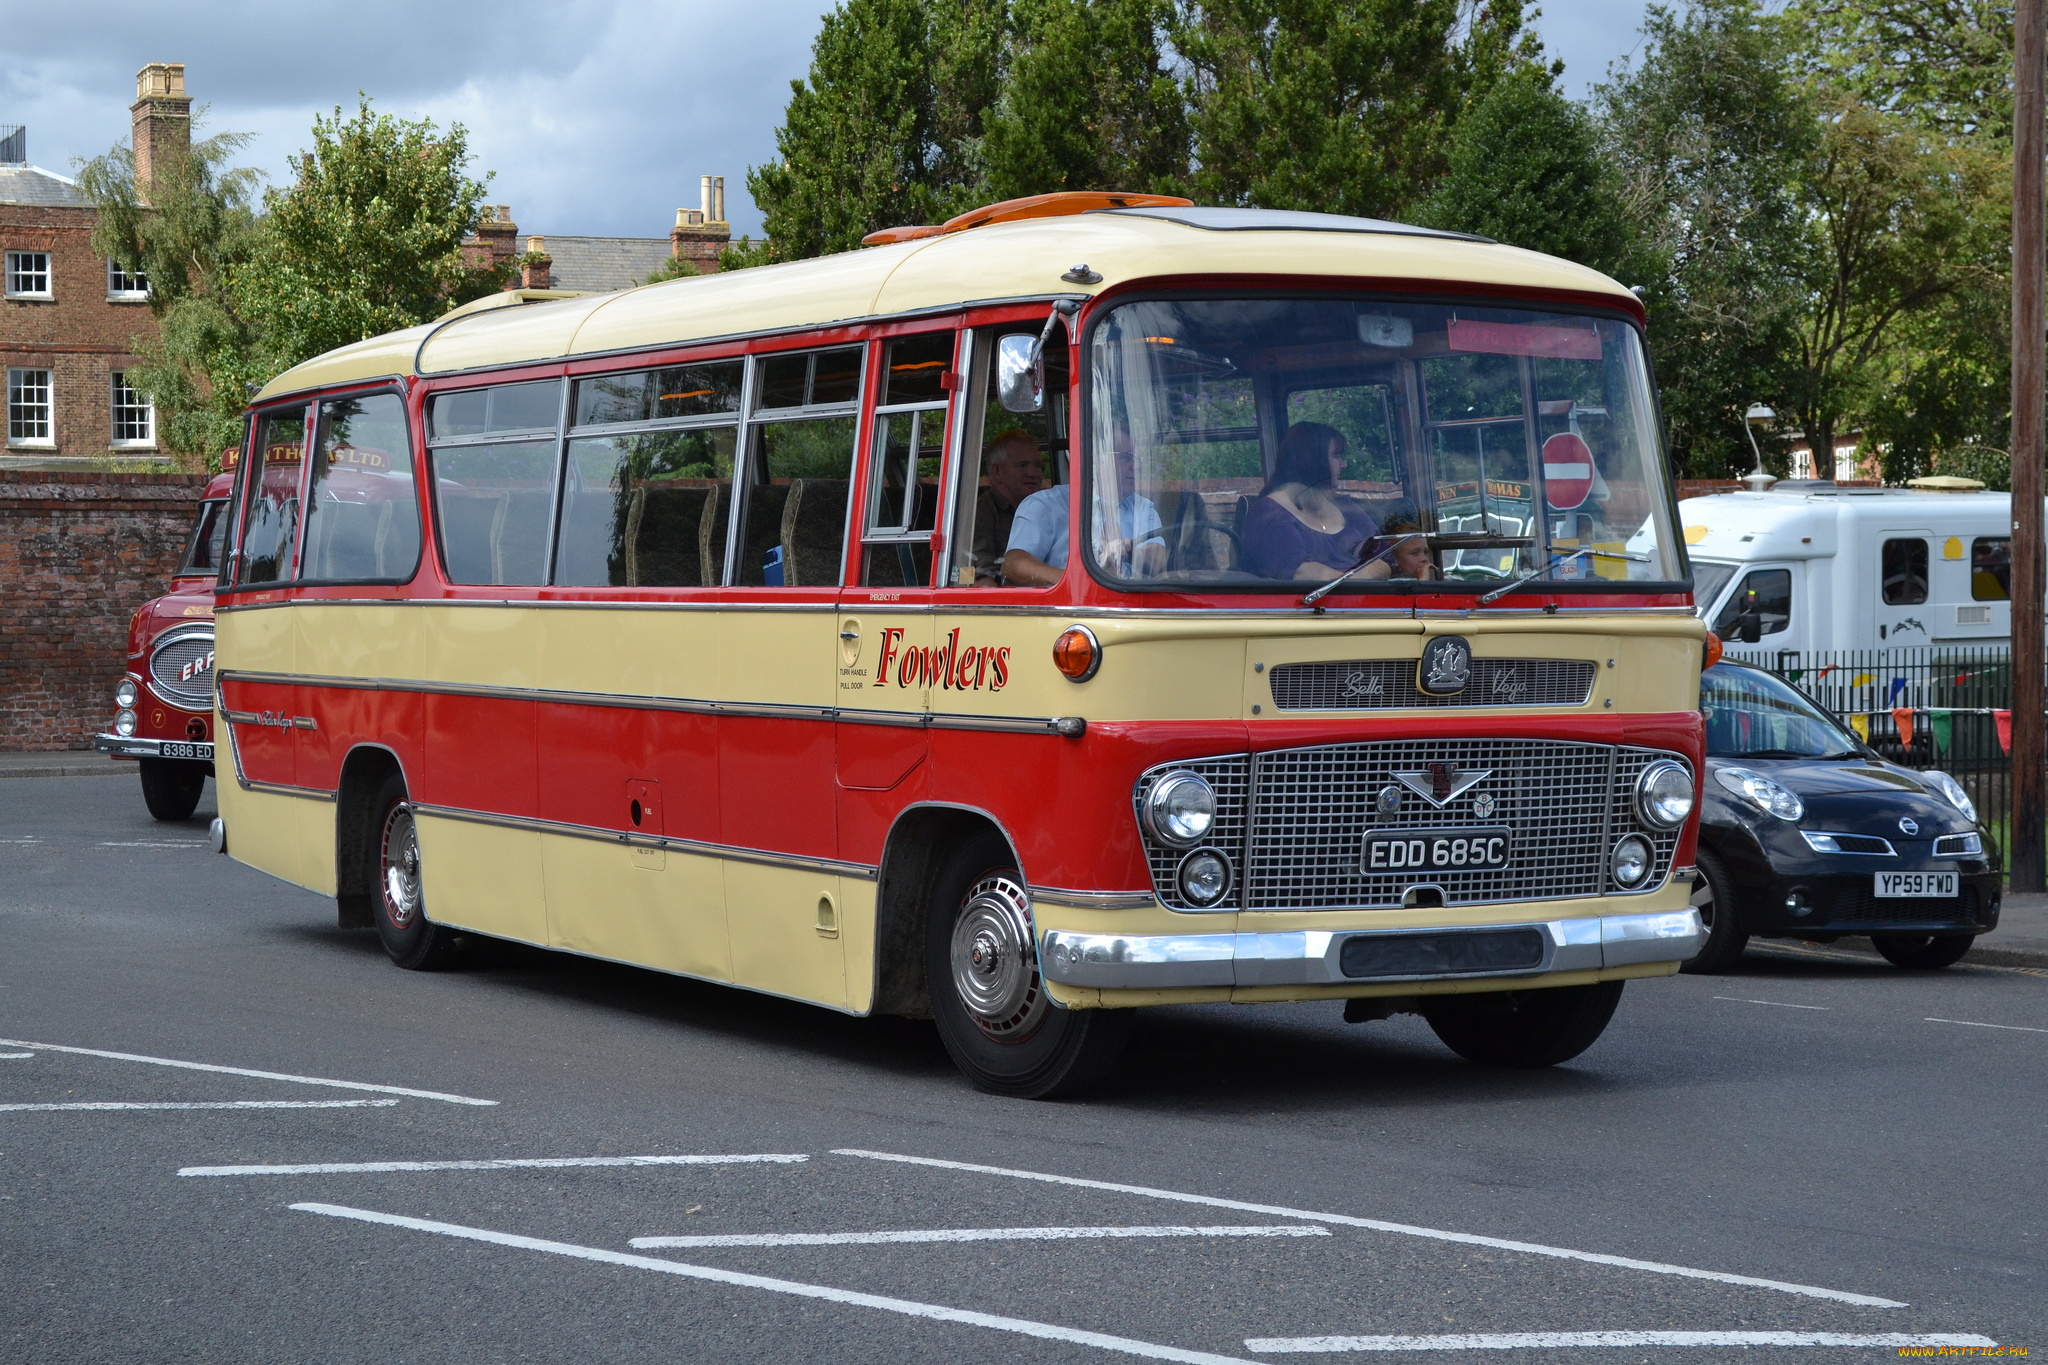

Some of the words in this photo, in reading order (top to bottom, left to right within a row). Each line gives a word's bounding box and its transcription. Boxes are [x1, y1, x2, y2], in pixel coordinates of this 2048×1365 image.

[273, 447, 344, 461] THOAS
[349, 449, 385, 467] LTD.
[870, 593, 890, 601] EMERGENCY
[182, 651, 214, 681] ERF
[873, 627, 1011, 691] Fowlers
[1341, 671, 1385, 697] Bella
[1492, 668, 1528, 702] Vega
[155, 713, 162, 723] 7
[163, 743, 194, 757] 6386
[1371, 840, 1425, 868] EDD
[1432, 837, 1504, 866] 685C
[1882, 875, 1922, 893] YP59
[1927, 875, 1953, 893] FWD
